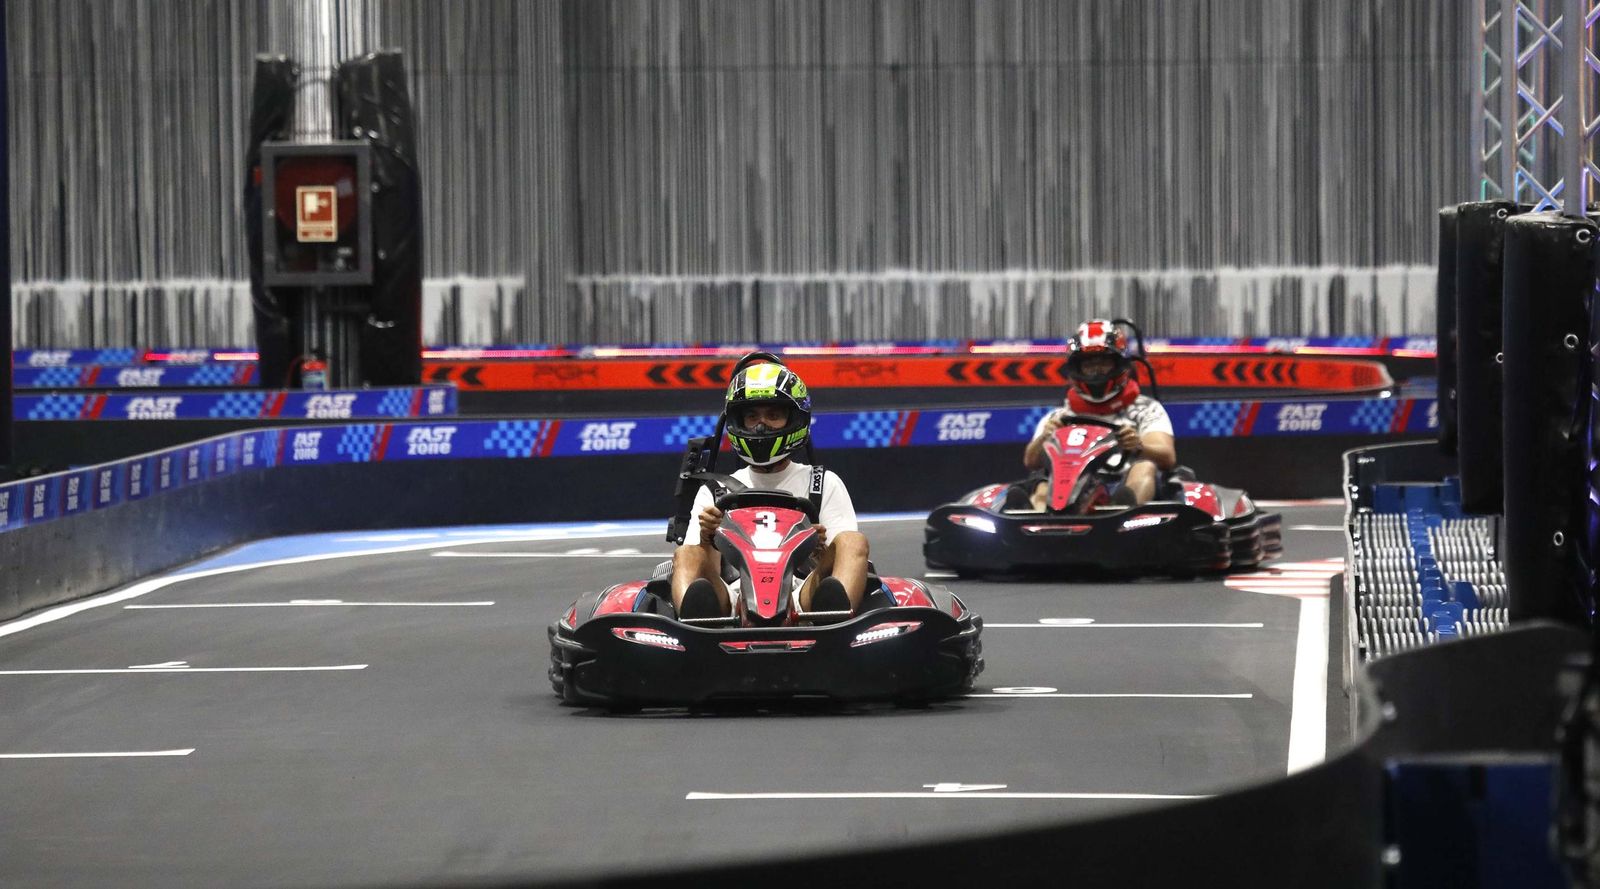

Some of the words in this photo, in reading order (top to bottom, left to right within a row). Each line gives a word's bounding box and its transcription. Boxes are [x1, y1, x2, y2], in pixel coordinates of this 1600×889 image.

[126, 397, 182, 412] FAST
[305, 394, 357, 410] FAST
[1277, 404, 1328, 420] FAST
[937, 413, 992, 428] FAST
[1277, 418, 1323, 431] zone
[406, 426, 457, 443] FAST
[578, 422, 637, 439] FAST
[938, 427, 987, 441] zone
[1066, 427, 1088, 447] 6
[293, 431, 323, 448] FAST
[580, 437, 631, 451] zone
[293, 446, 319, 460] zone
[407, 441, 451, 455] zone
[754, 511, 778, 533] 3
